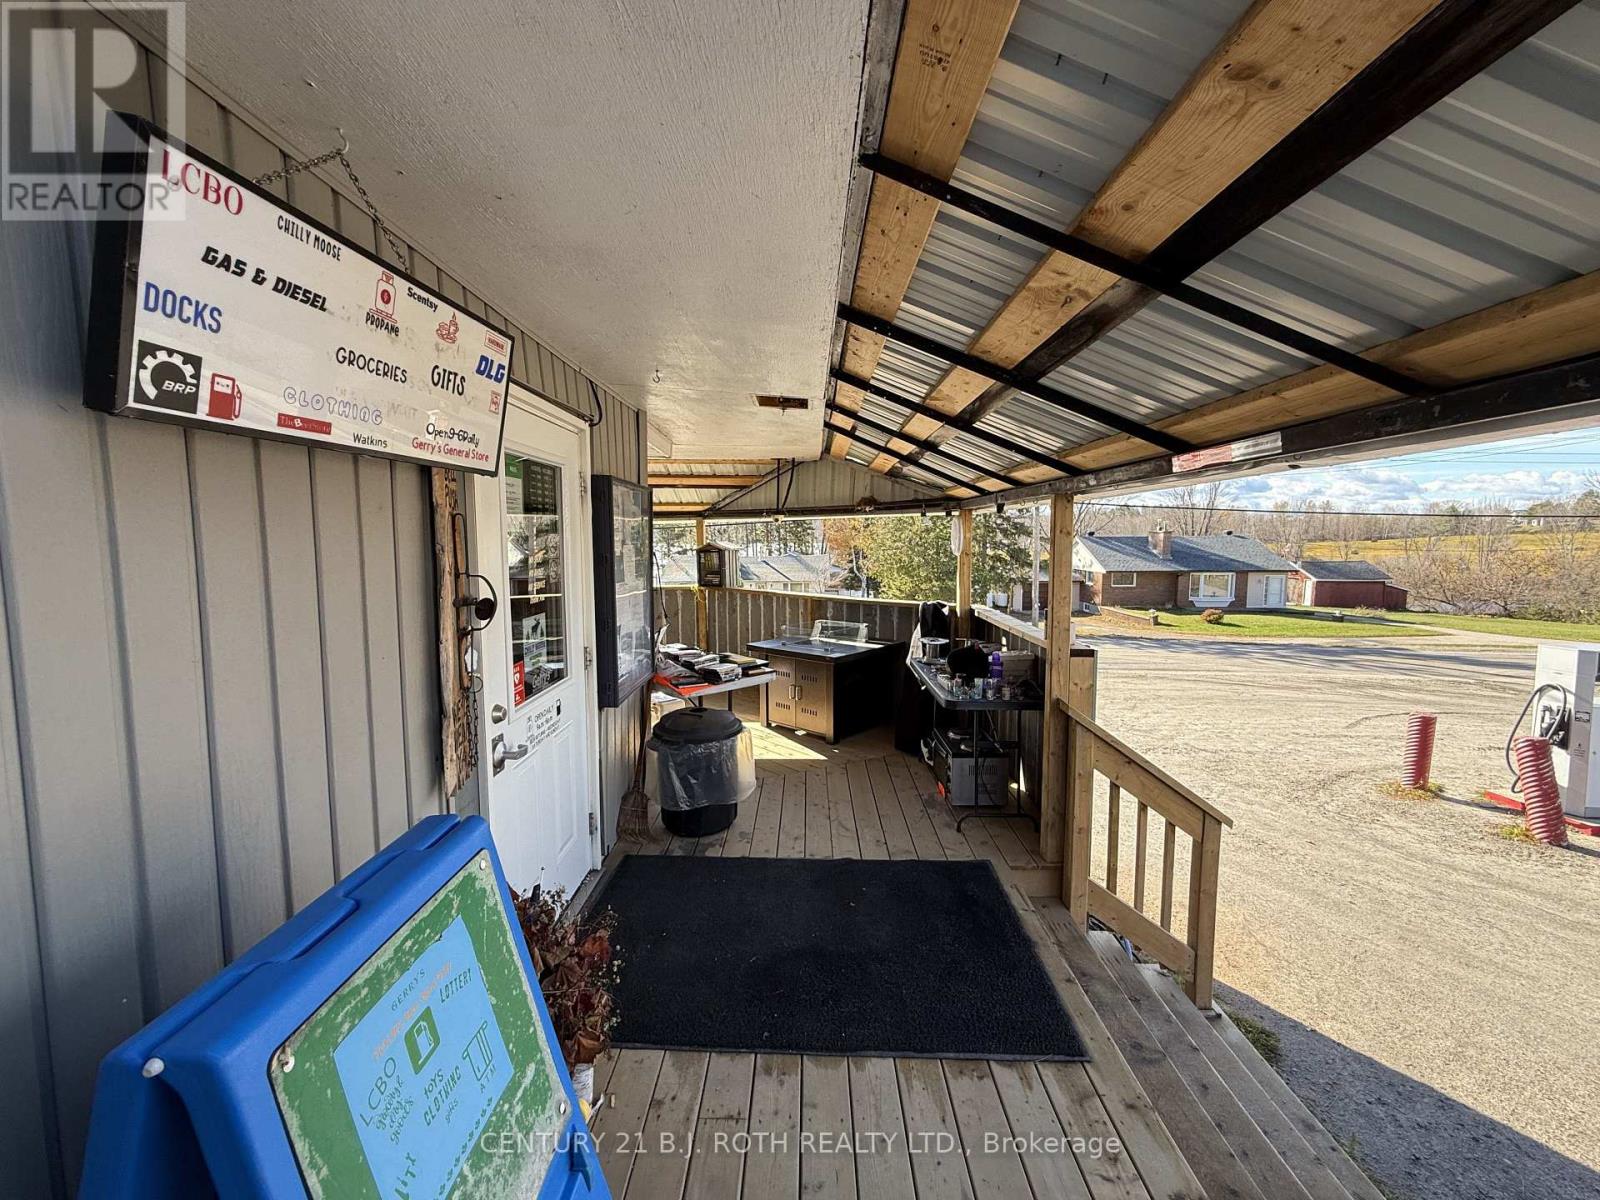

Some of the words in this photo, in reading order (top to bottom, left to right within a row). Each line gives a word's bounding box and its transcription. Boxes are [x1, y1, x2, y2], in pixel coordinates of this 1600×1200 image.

[162, 147, 243, 216] LCBO
[277, 214, 312, 245] CHILLY
[313, 233, 342, 262] MOOSE
[201, 246, 247, 277] GAS
[251, 267, 267, 286] &
[272, 276, 328, 312] DIESEL
[143, 281, 223, 334] DOCKS
[407, 286, 439, 312] Scentsy
[335, 346, 408, 384] GROCERIES
[431, 364, 466, 396] GIFTS
[475, 354, 506, 384] DLG
[162, 380, 196, 394] BRP
[283, 386, 383, 426] CLOTHING
[352, 432, 388, 449] Watkins
[412, 436, 441, 455] Gerry's
[443, 443, 470, 459] General
[471, 449, 489, 462] Store
[426, 422, 449, 440] Open
[391, 968, 426, 1012] GERRY'S
[360, 1057, 396, 1127] LCBO
[423, 1065, 462, 1127] CLOTHING
